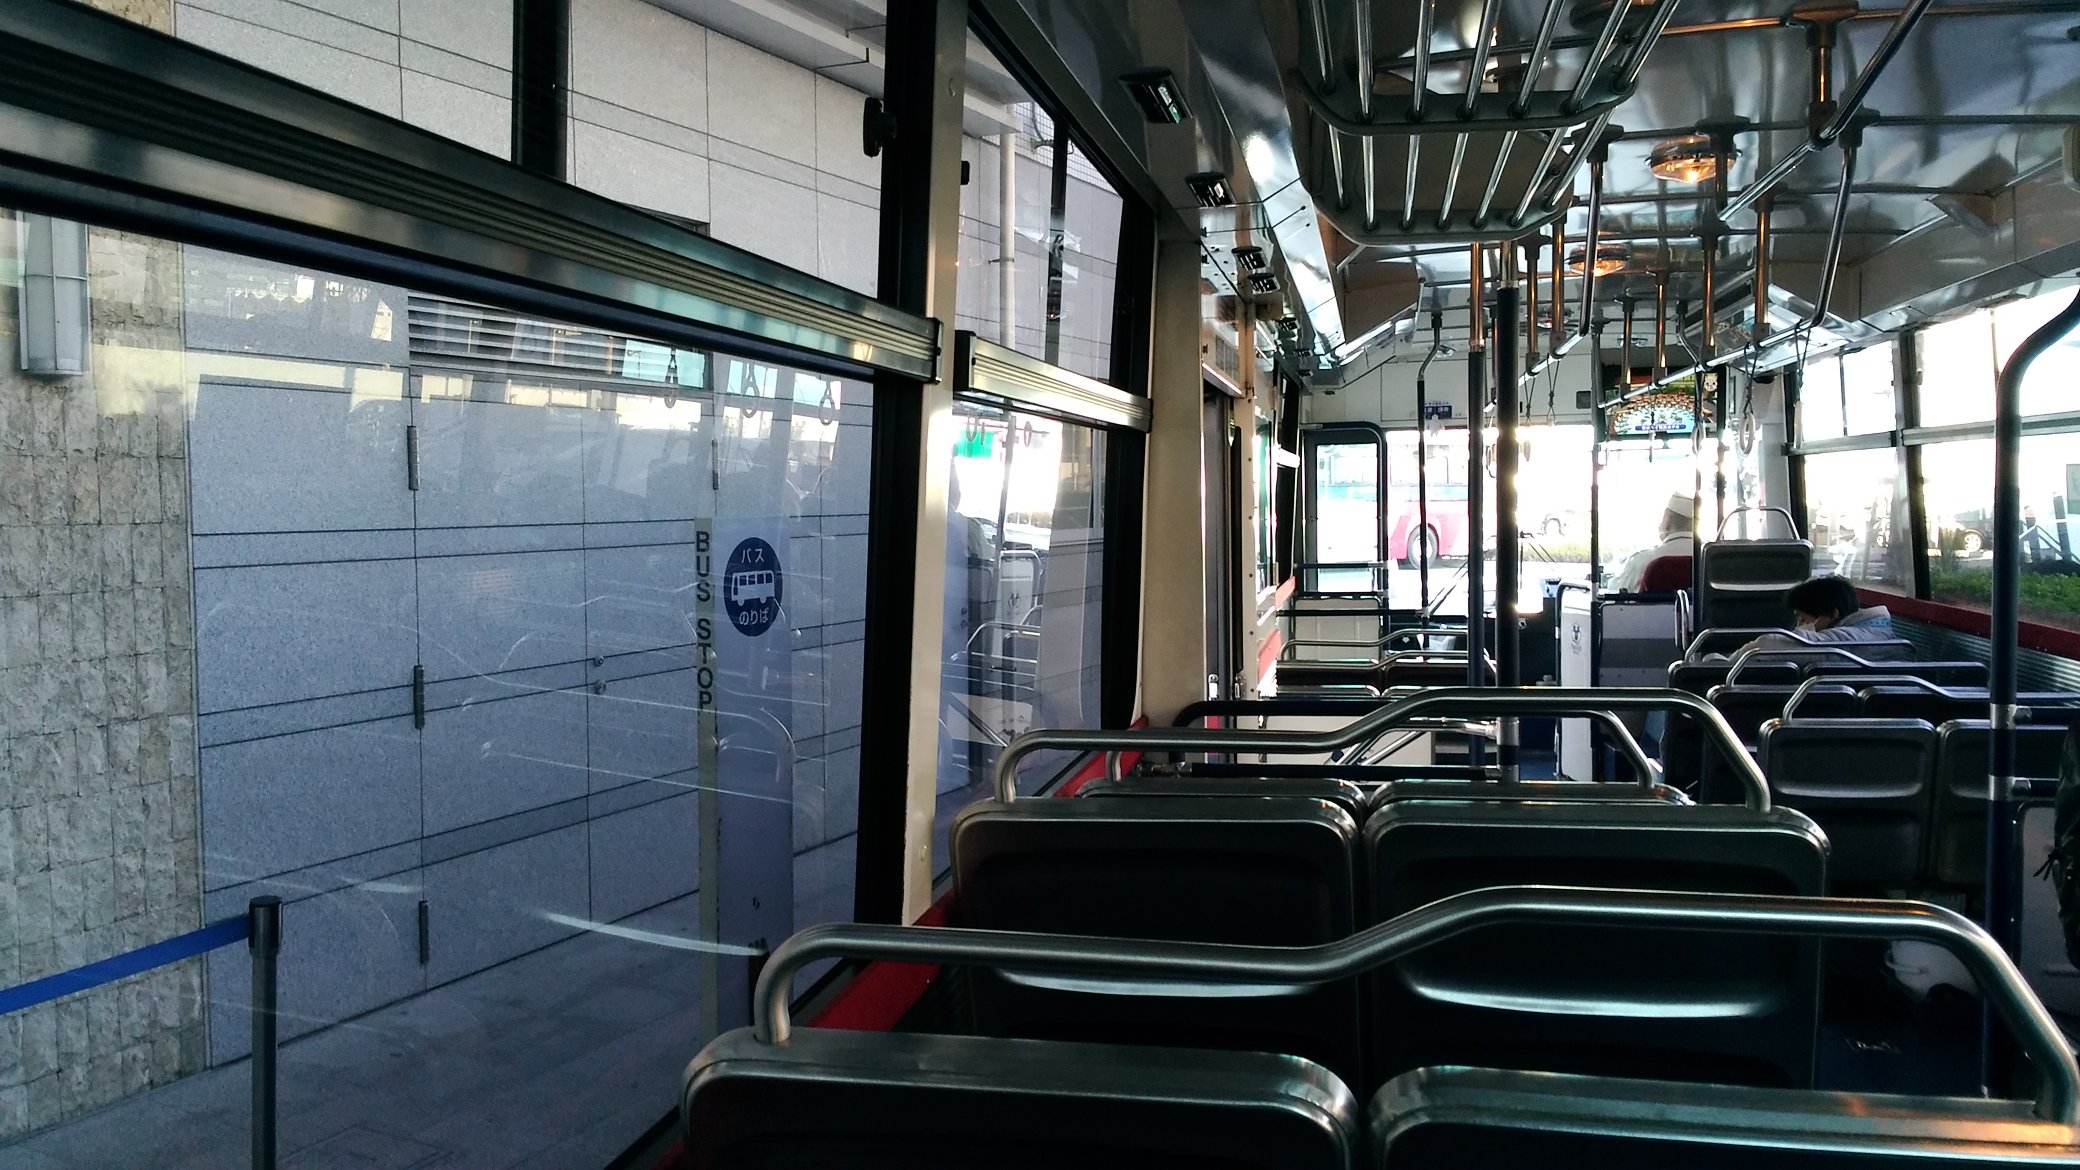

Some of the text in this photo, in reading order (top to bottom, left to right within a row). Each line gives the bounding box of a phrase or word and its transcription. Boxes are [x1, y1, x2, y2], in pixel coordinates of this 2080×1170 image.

[741, 548, 765, 564] バス
[696, 531, 713, 710] BUS STOP
[739, 607, 770, 626] のりば
